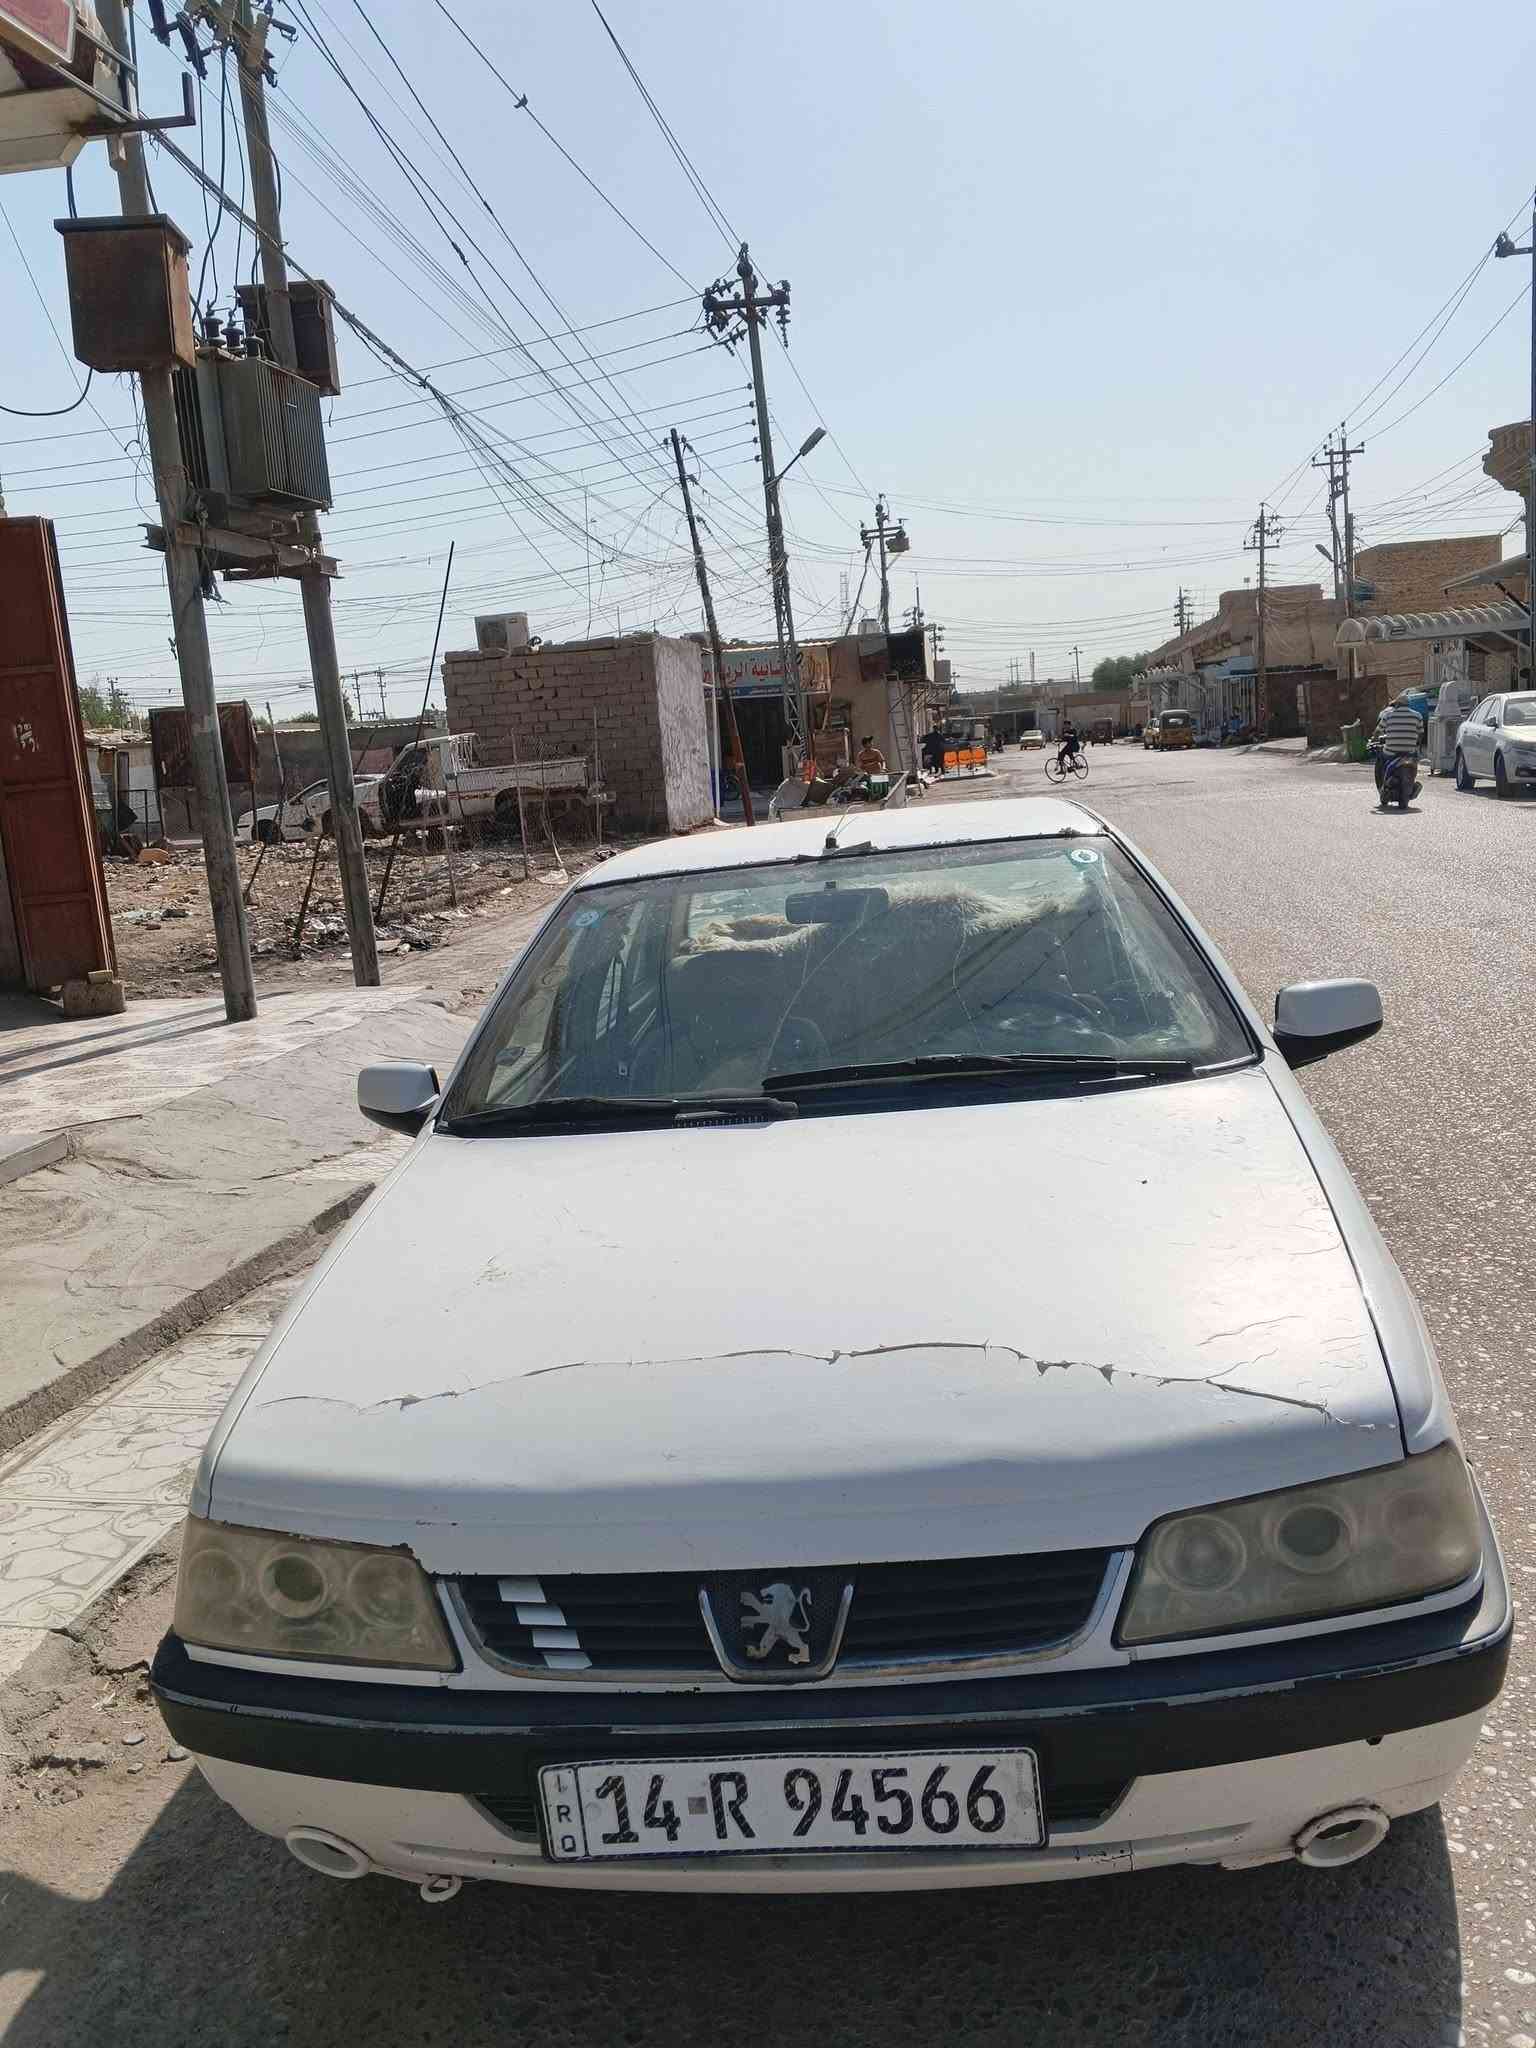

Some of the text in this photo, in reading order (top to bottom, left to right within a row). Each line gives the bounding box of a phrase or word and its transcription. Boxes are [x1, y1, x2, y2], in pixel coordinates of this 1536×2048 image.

[595, 1764, 1006, 1844] 14 R 94566
